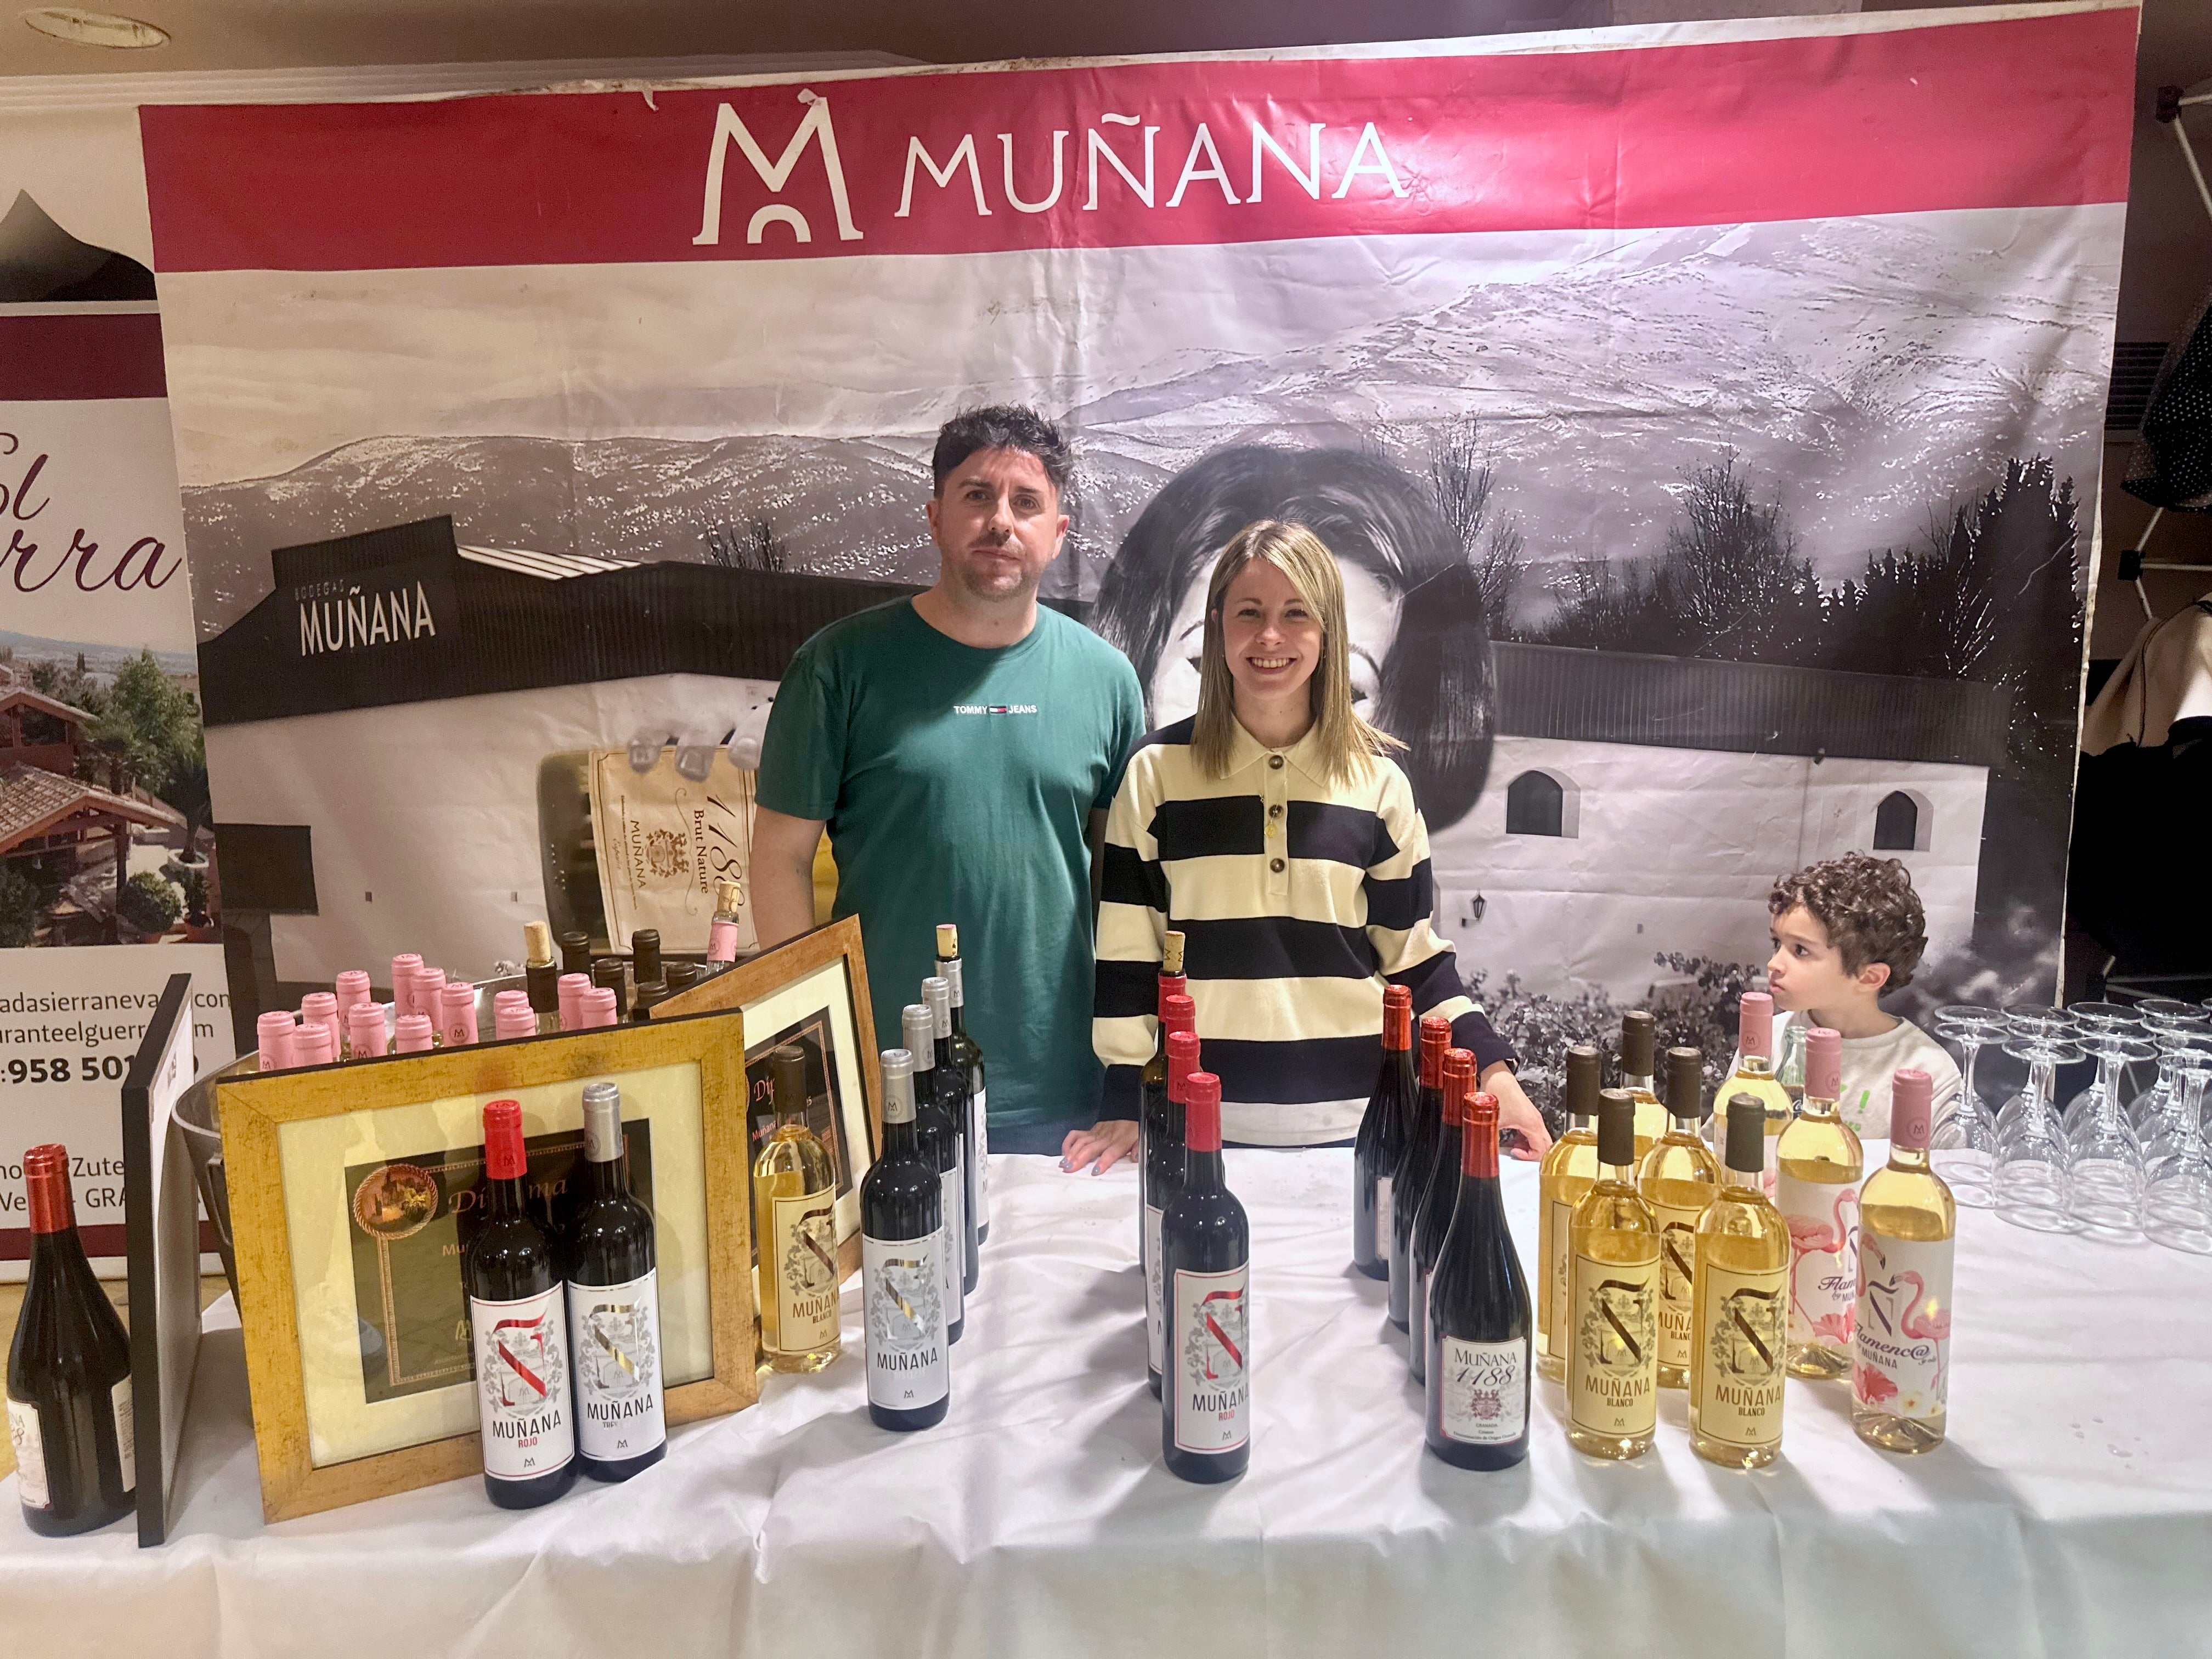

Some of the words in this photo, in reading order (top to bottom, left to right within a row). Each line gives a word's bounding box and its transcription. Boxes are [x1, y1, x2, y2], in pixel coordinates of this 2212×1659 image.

[895, 115, 1409, 217] MUÑANA
[300, 580, 436, 657] MUÑANA
[953, 706, 988, 714] TOMMY
[1009, 704, 1037, 713] JEANS
[694, 809, 705, 842] Brut
[630, 820, 646, 889] MUÑANA
[696, 845, 709, 894] Nature
[812, 1310, 832, 1324] BLANCO
[877, 1347, 938, 1371] MUÑANA
[1861, 1347, 1898, 1370] MUÑANA
[1456, 1365, 1515, 1386] 1188
[1585, 1376, 1650, 1397] MUÑANA
[588, 1394, 653, 1420] MUÑANA
[1607, 1397, 1633, 1408] BLANCO
[1716, 1384, 1781, 1407] MUÑANA
[1218, 1409, 1235, 1421] ROJO
[1738, 1406, 1765, 1417] BLANCO
[493, 1410, 561, 1439] MUÑANA
[518, 1437, 538, 1448] ROJO
